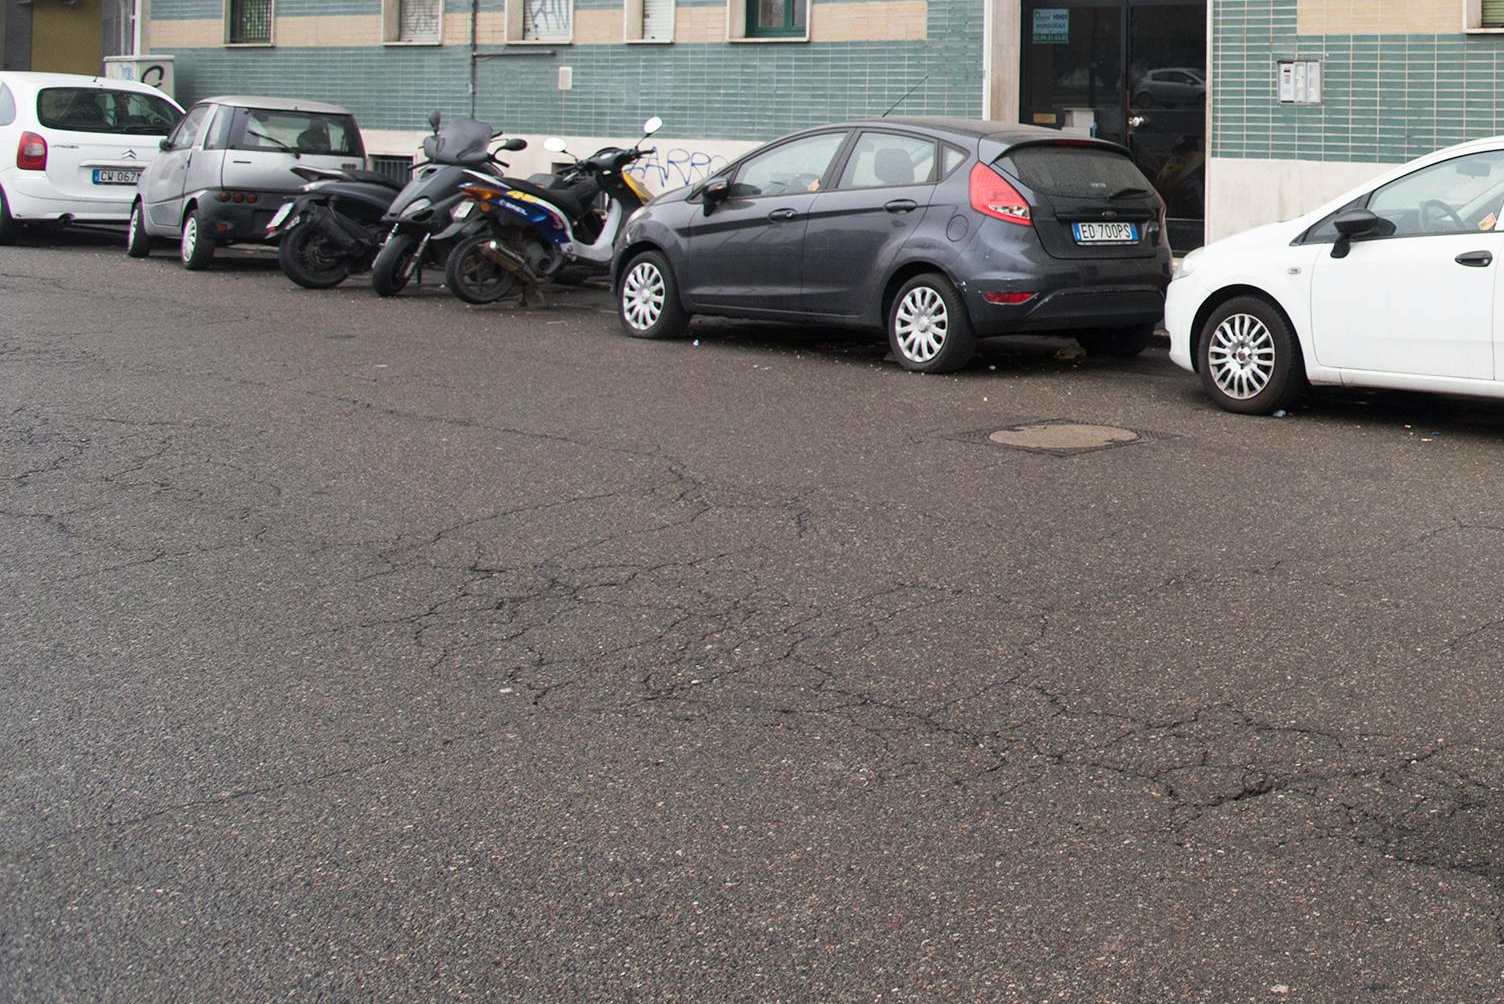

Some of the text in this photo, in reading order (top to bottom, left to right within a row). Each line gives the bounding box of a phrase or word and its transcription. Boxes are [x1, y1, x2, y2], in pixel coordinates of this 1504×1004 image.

[101, 171, 114, 181] CW
[1081, 224, 1132, 239] ED 700PS
